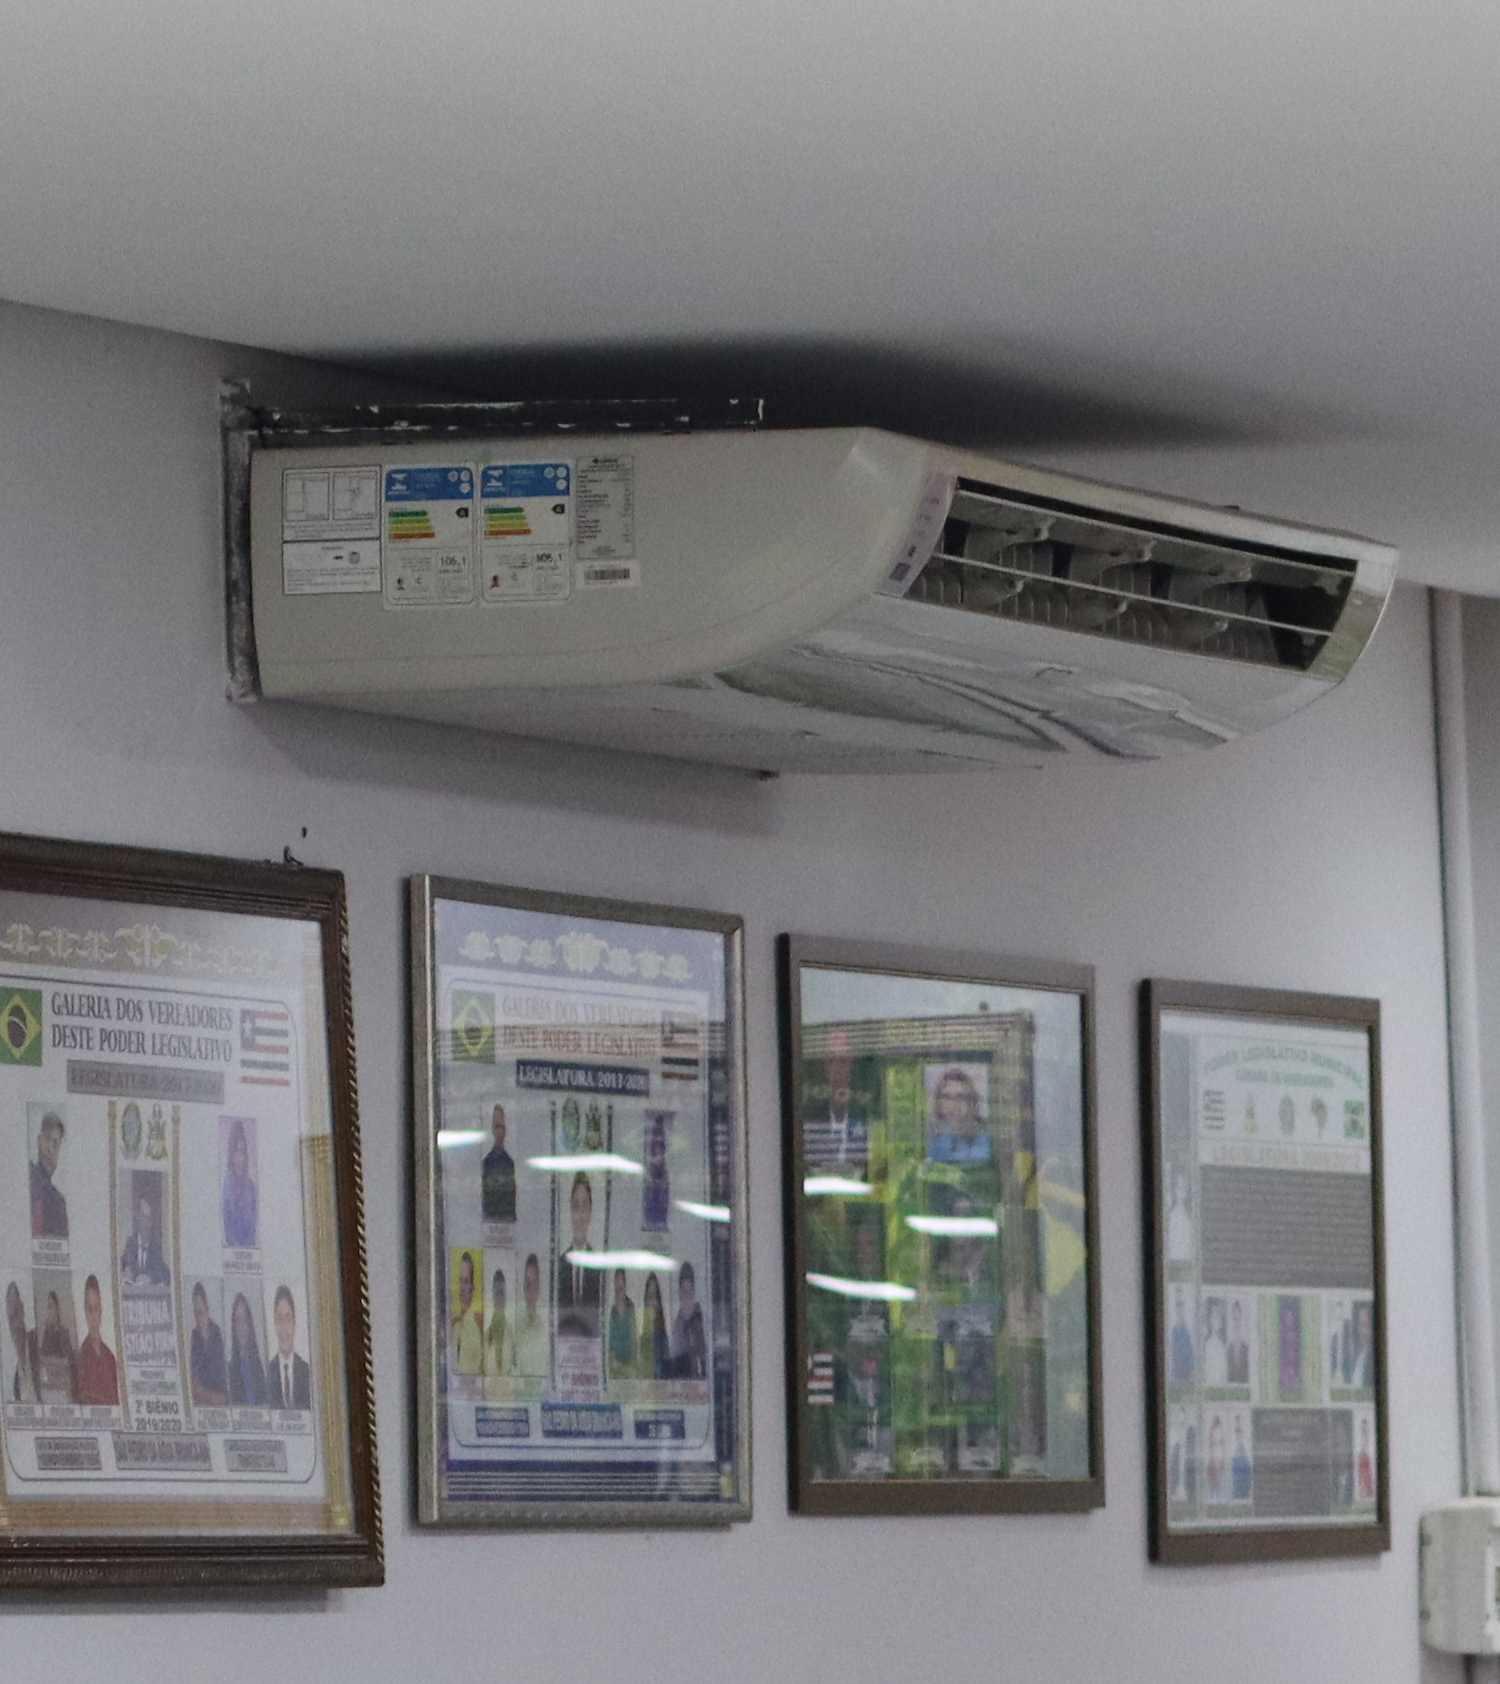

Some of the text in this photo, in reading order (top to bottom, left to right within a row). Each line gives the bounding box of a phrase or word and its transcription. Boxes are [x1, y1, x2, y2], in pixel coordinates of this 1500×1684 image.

[51, 991, 233, 1031] GALERIA DOS VEREADORES
[52, 1024, 233, 1062] DESTE PODER LEGISLATIVO
[519, 1065, 595, 1087] LEGISLATURA
[145, 1397, 179, 1415] BIÊNIO
